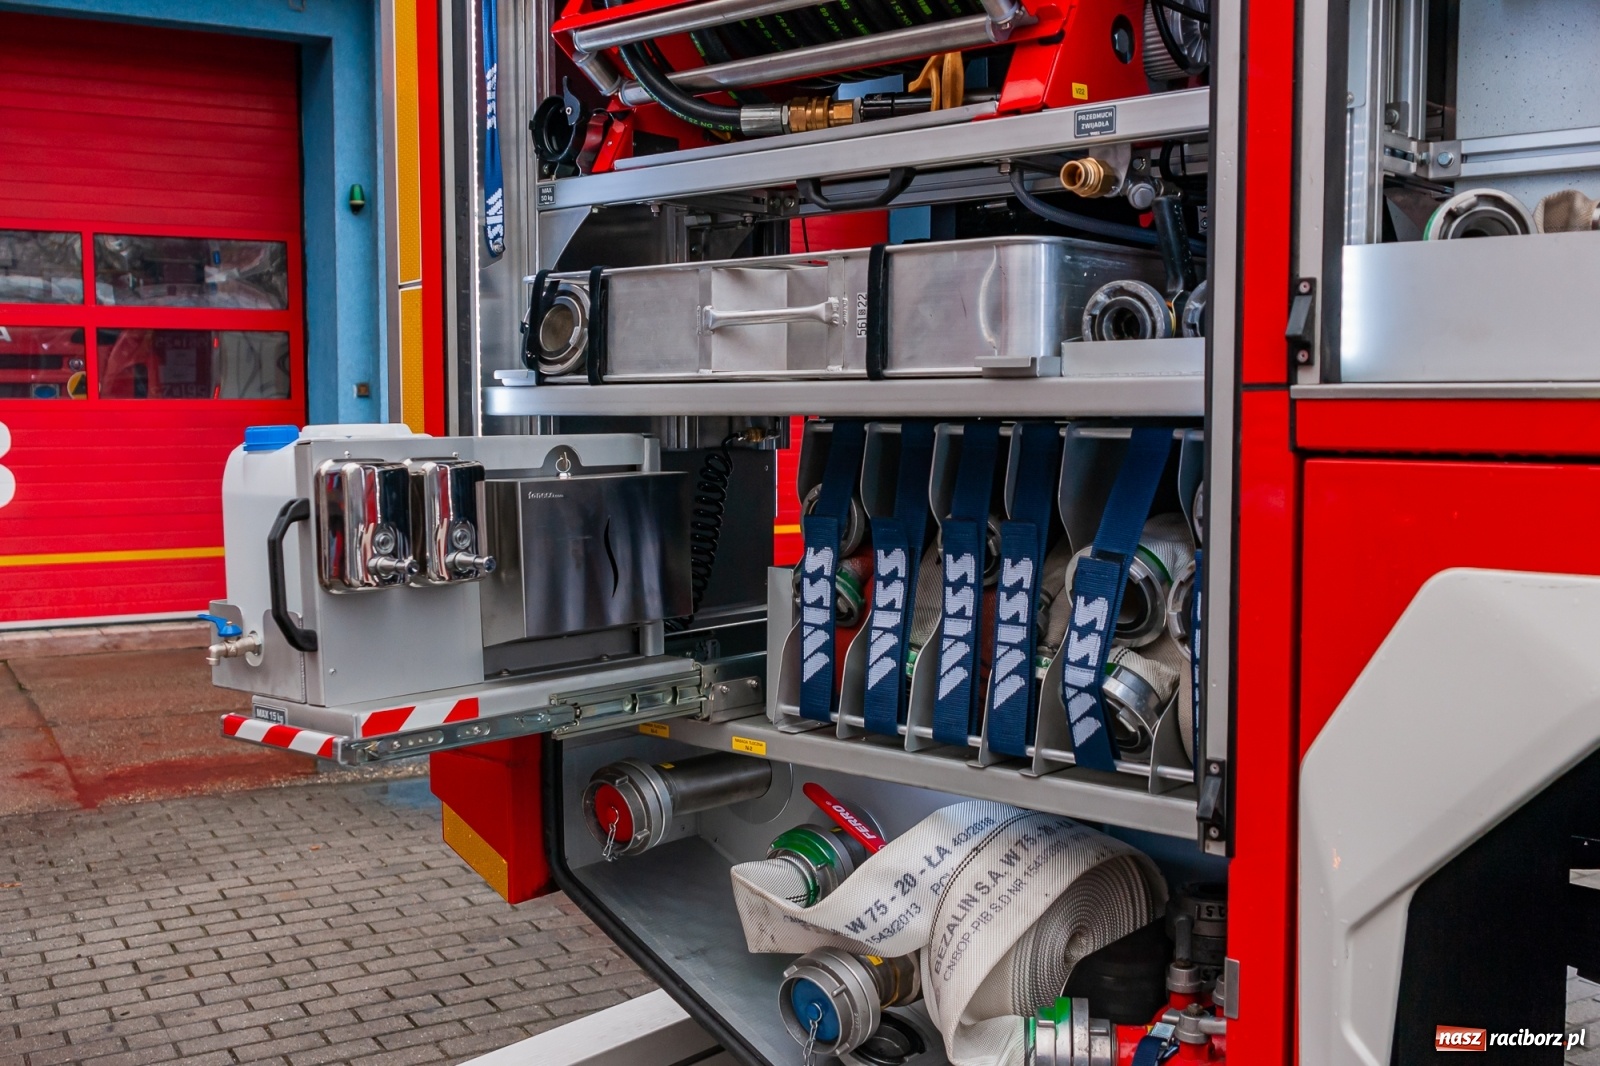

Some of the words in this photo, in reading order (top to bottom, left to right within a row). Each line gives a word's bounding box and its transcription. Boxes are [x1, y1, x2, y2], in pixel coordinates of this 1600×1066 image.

[1077, 111, 1113, 122] PRZEDMUCH
[1081, 120, 1110, 130] ZWIJADŁA
[803, 546, 834, 683] WISS
[868, 548, 906, 691] WISS
[938, 552, 976, 701] WISS
[993, 557, 1034, 710] WISS
[256, 708, 270, 719] MAX
[269, 711, 277, 721] 15
[1064, 595, 1109, 748] WISS
[831, 804, 877, 839] FERRO
[934, 893, 980, 975] BEZALIN
